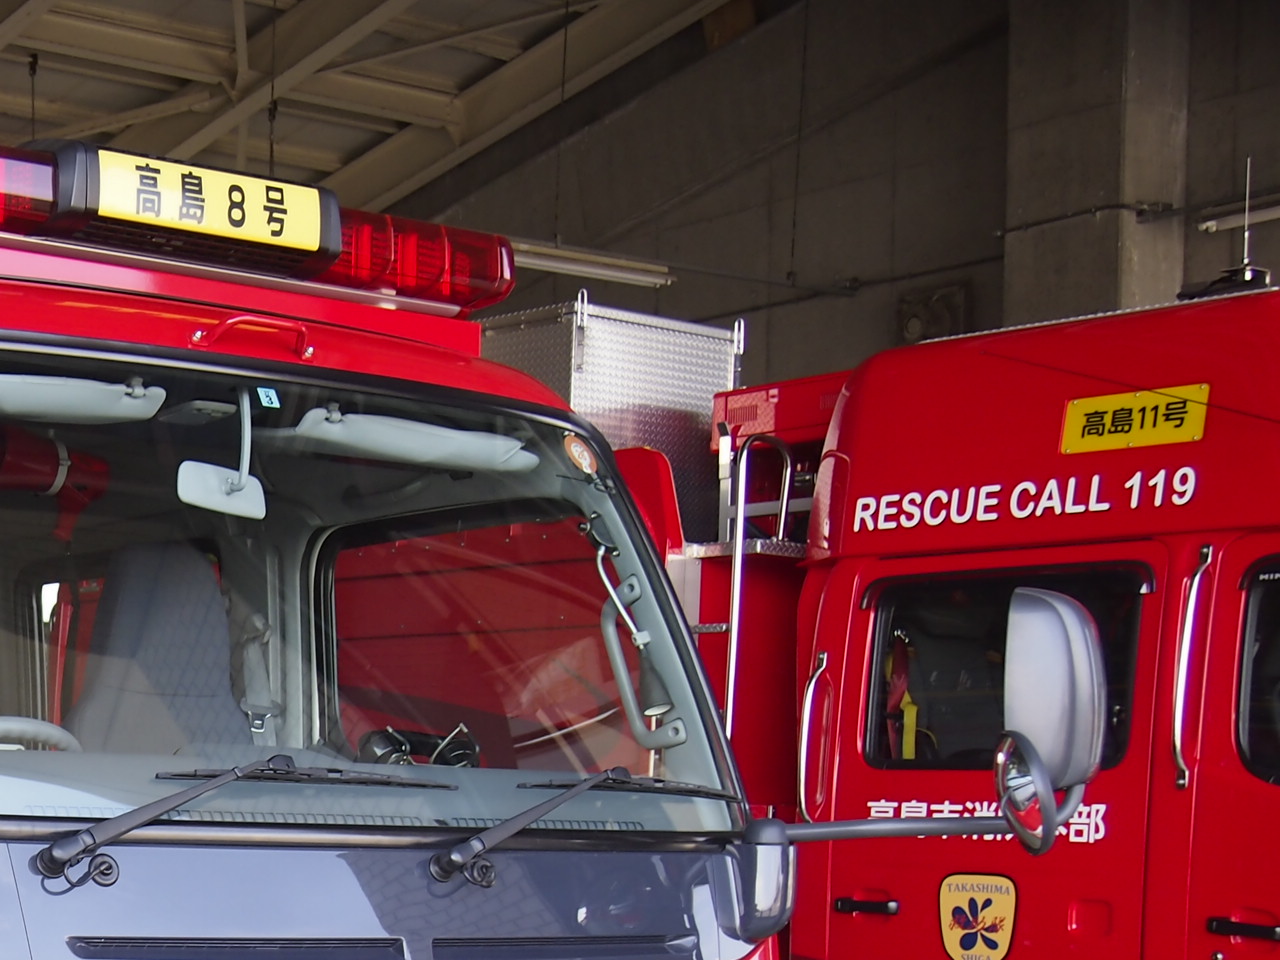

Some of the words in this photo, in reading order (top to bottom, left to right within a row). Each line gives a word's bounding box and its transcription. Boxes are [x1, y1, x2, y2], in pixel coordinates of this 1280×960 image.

[135, 163, 288, 238] 高島8号
[1081, 400, 1189, 439] 高島11号
[853, 484, 1002, 532] RESCUE
[1010, 474, 1111, 518] CALL
[1124, 466, 1197, 509] 119
[946, 883, 1011, 896] TAKASHIMA
